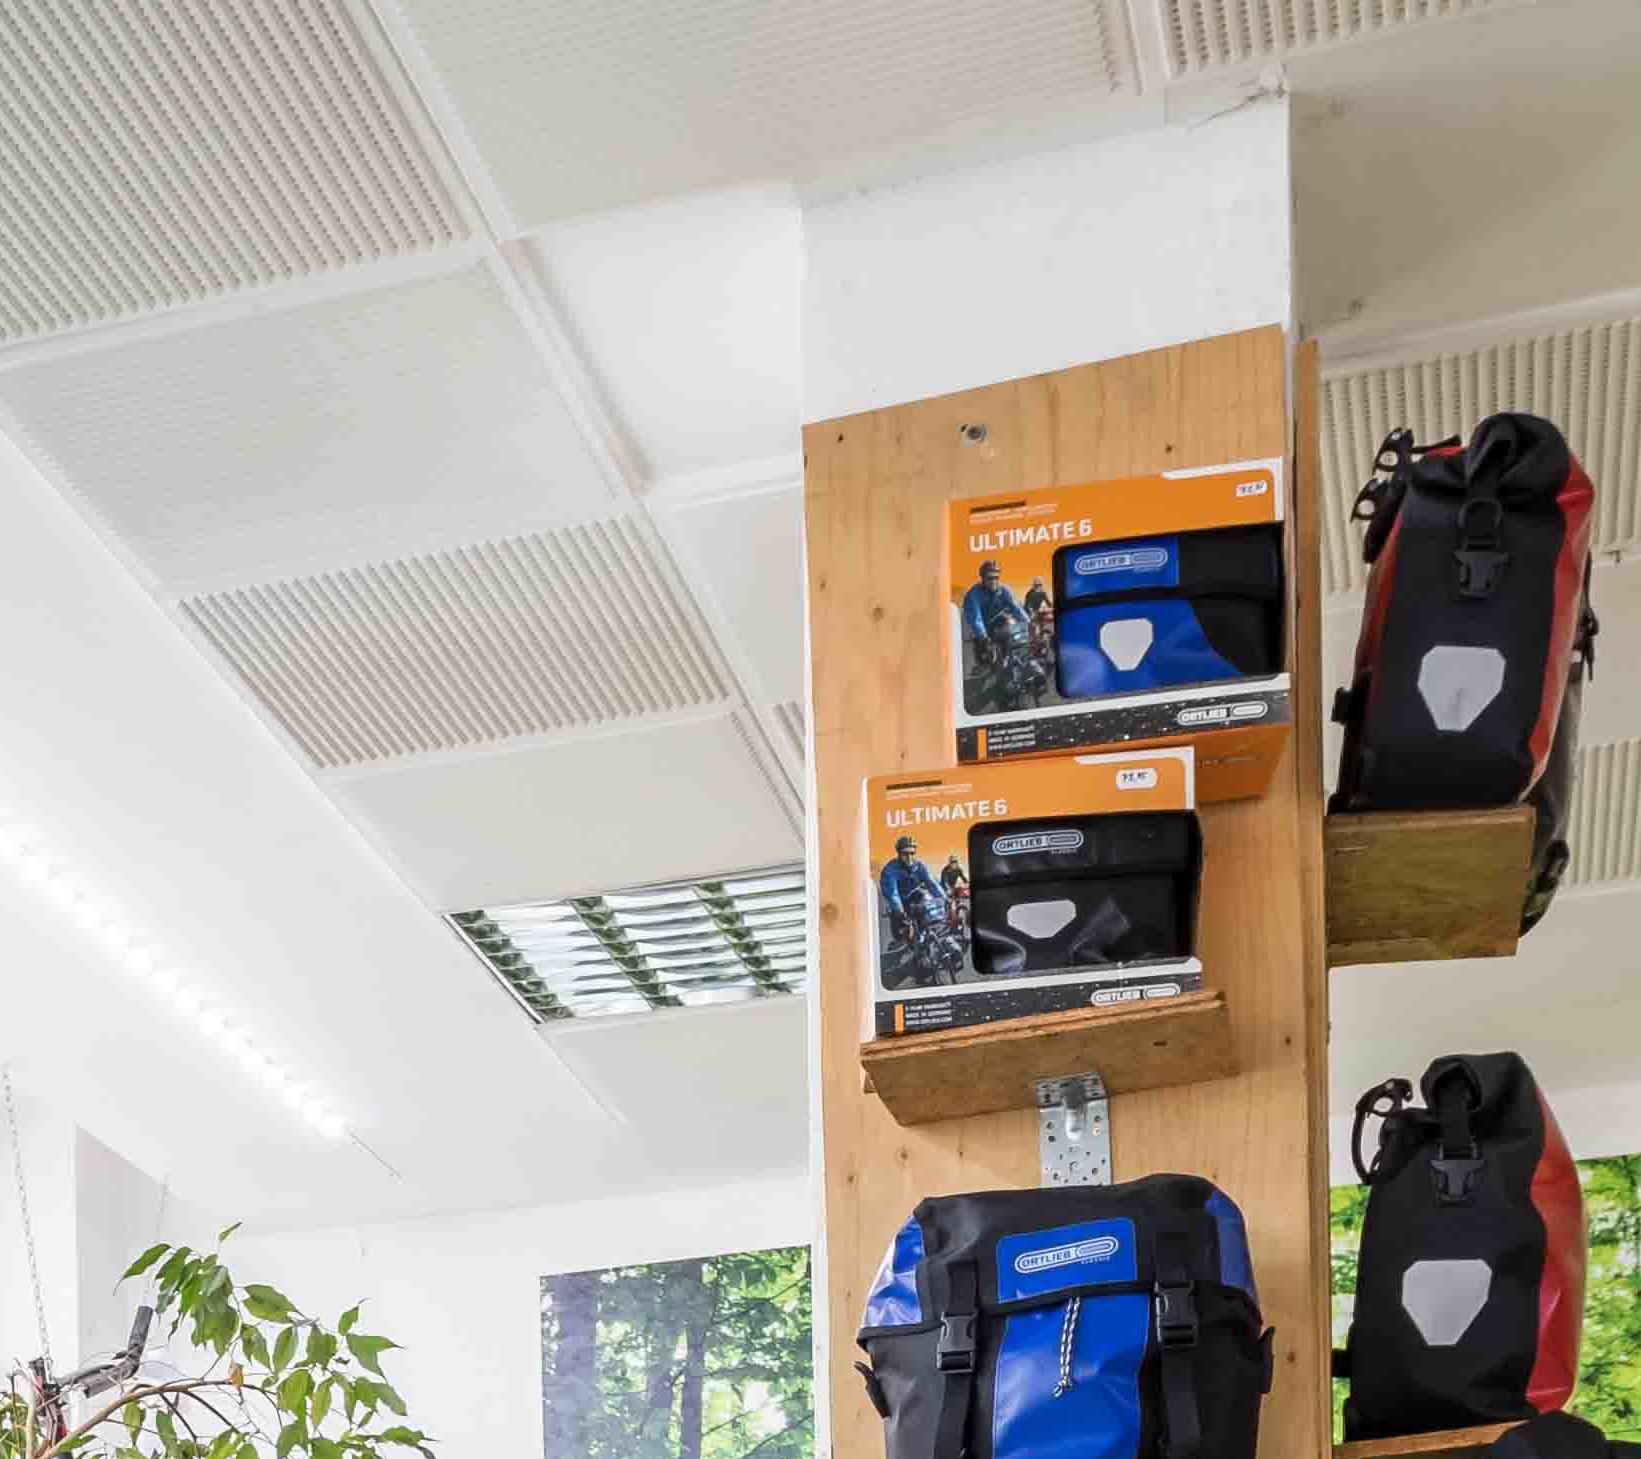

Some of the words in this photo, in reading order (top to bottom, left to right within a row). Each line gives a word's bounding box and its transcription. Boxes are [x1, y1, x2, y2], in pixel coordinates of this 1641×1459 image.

[969, 520, 1076, 552] ULTIMATE
[1078, 518, 1093, 537] 6
[886, 800, 990, 827] ULTIMATE
[994, 799, 1008, 815] 6
